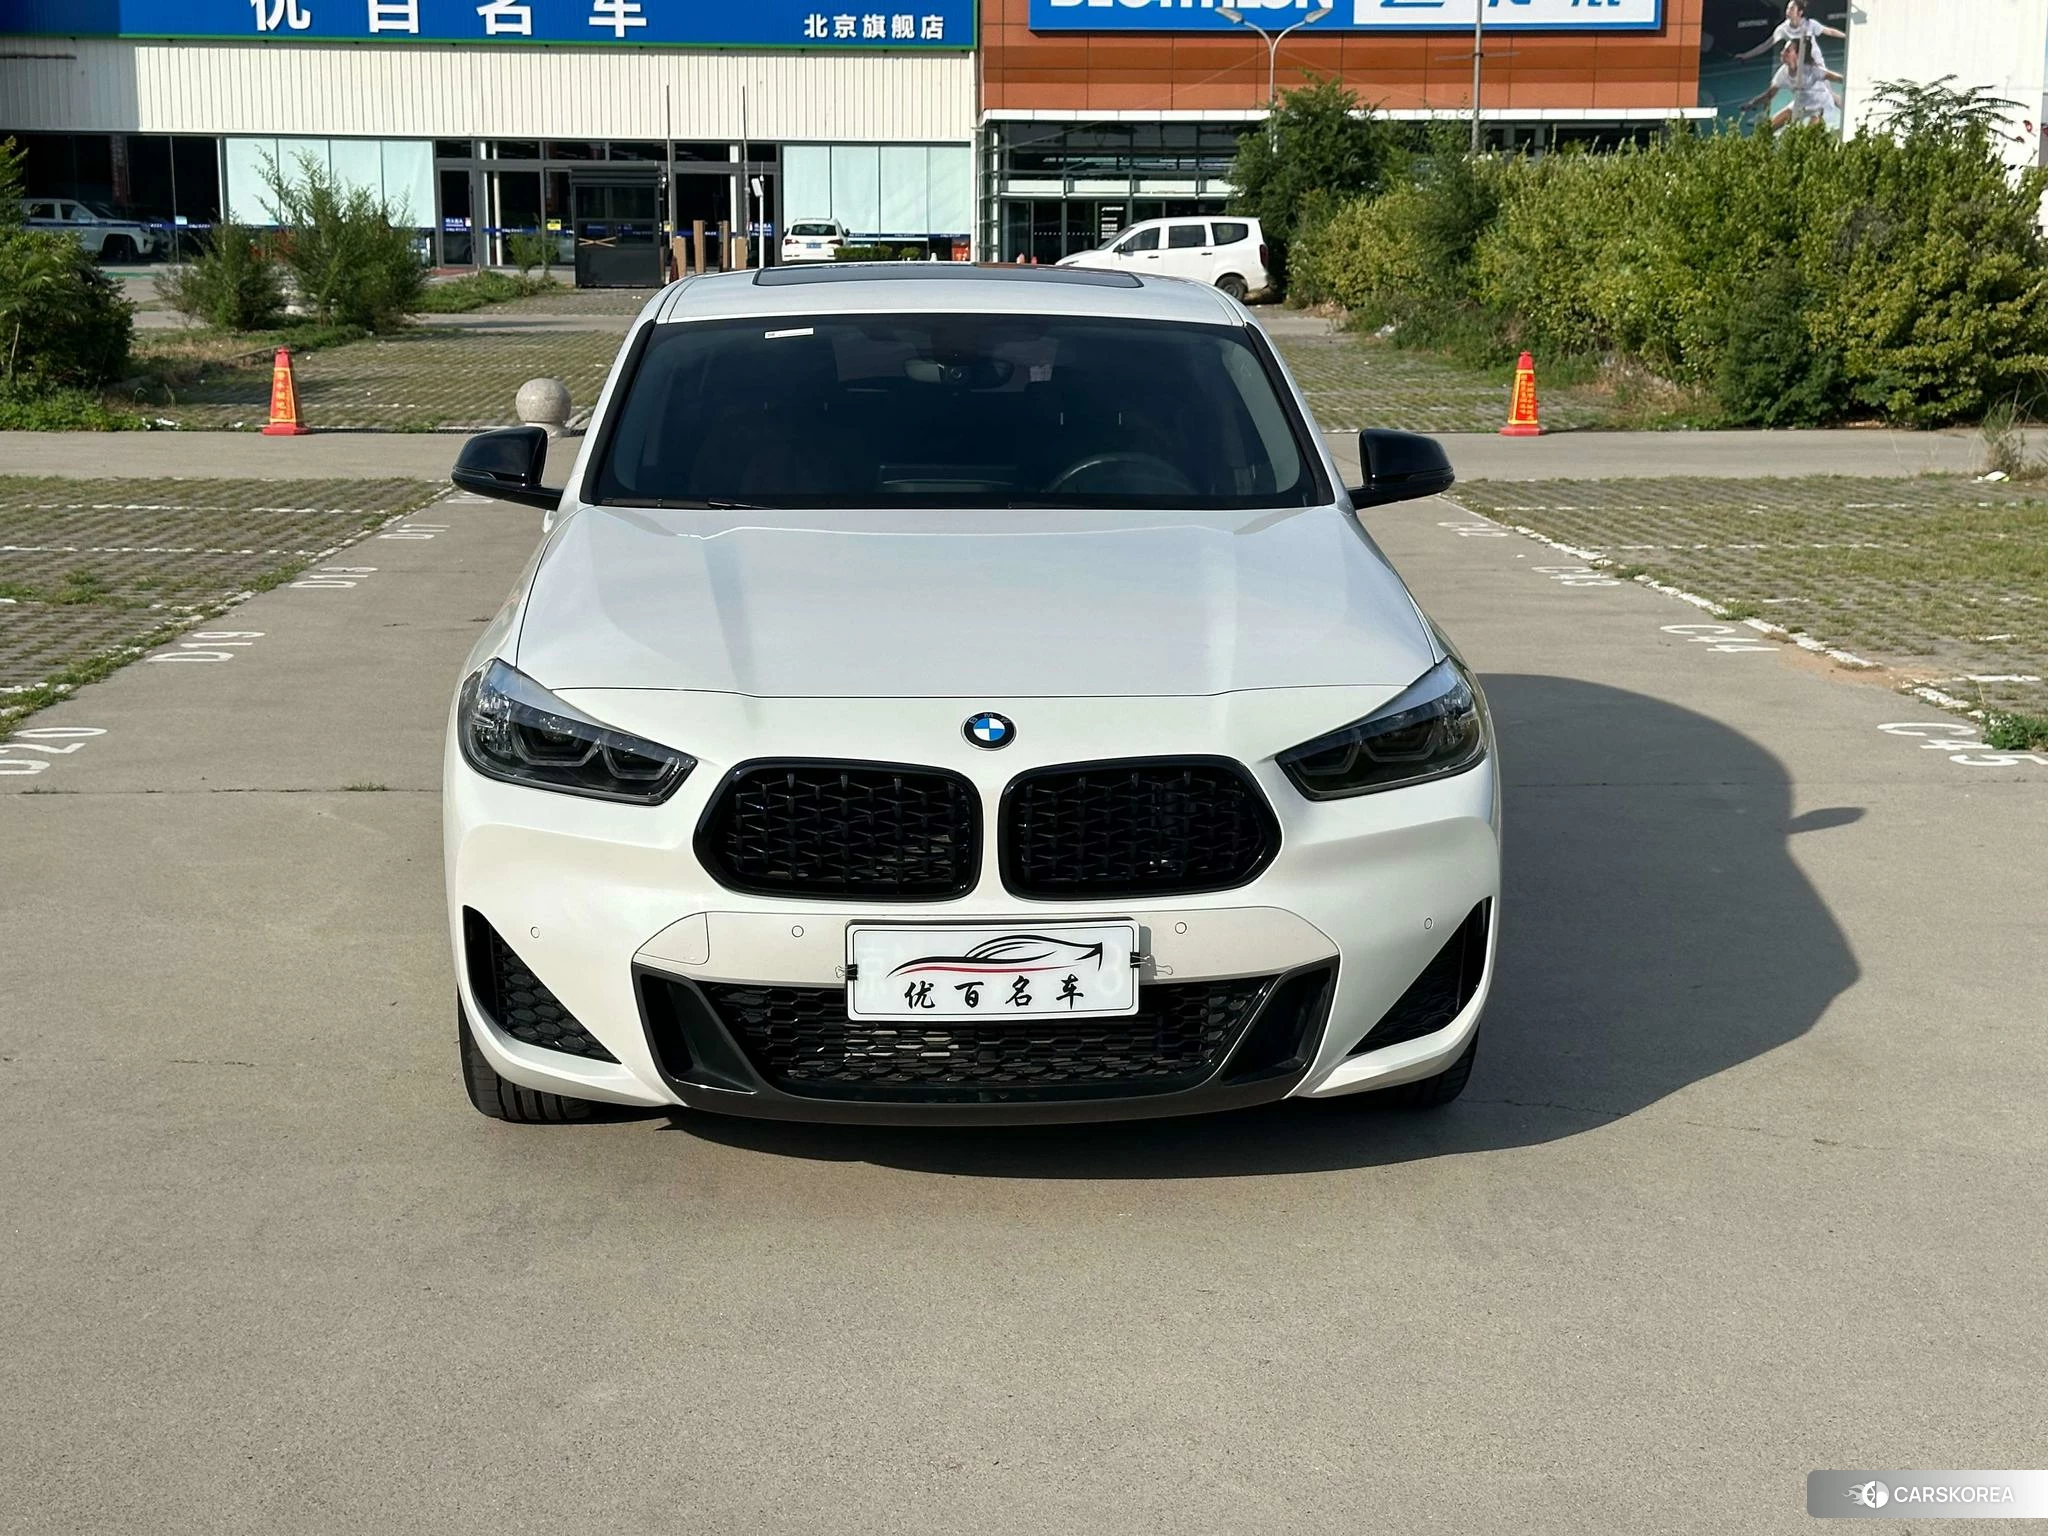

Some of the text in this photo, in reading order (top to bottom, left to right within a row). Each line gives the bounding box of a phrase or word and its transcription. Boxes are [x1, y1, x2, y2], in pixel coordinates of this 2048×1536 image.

[804, 13, 944, 39] 北京旗舰店
[1531, 566, 1622, 587] C43
[146, 631, 266, 662] D19
[1659, 624, 1781, 653] C44
[0, 727, 108, 775] D20
[1877, 722, 2048, 767] C45
[904, 974, 1085, 1010] 优百名车
